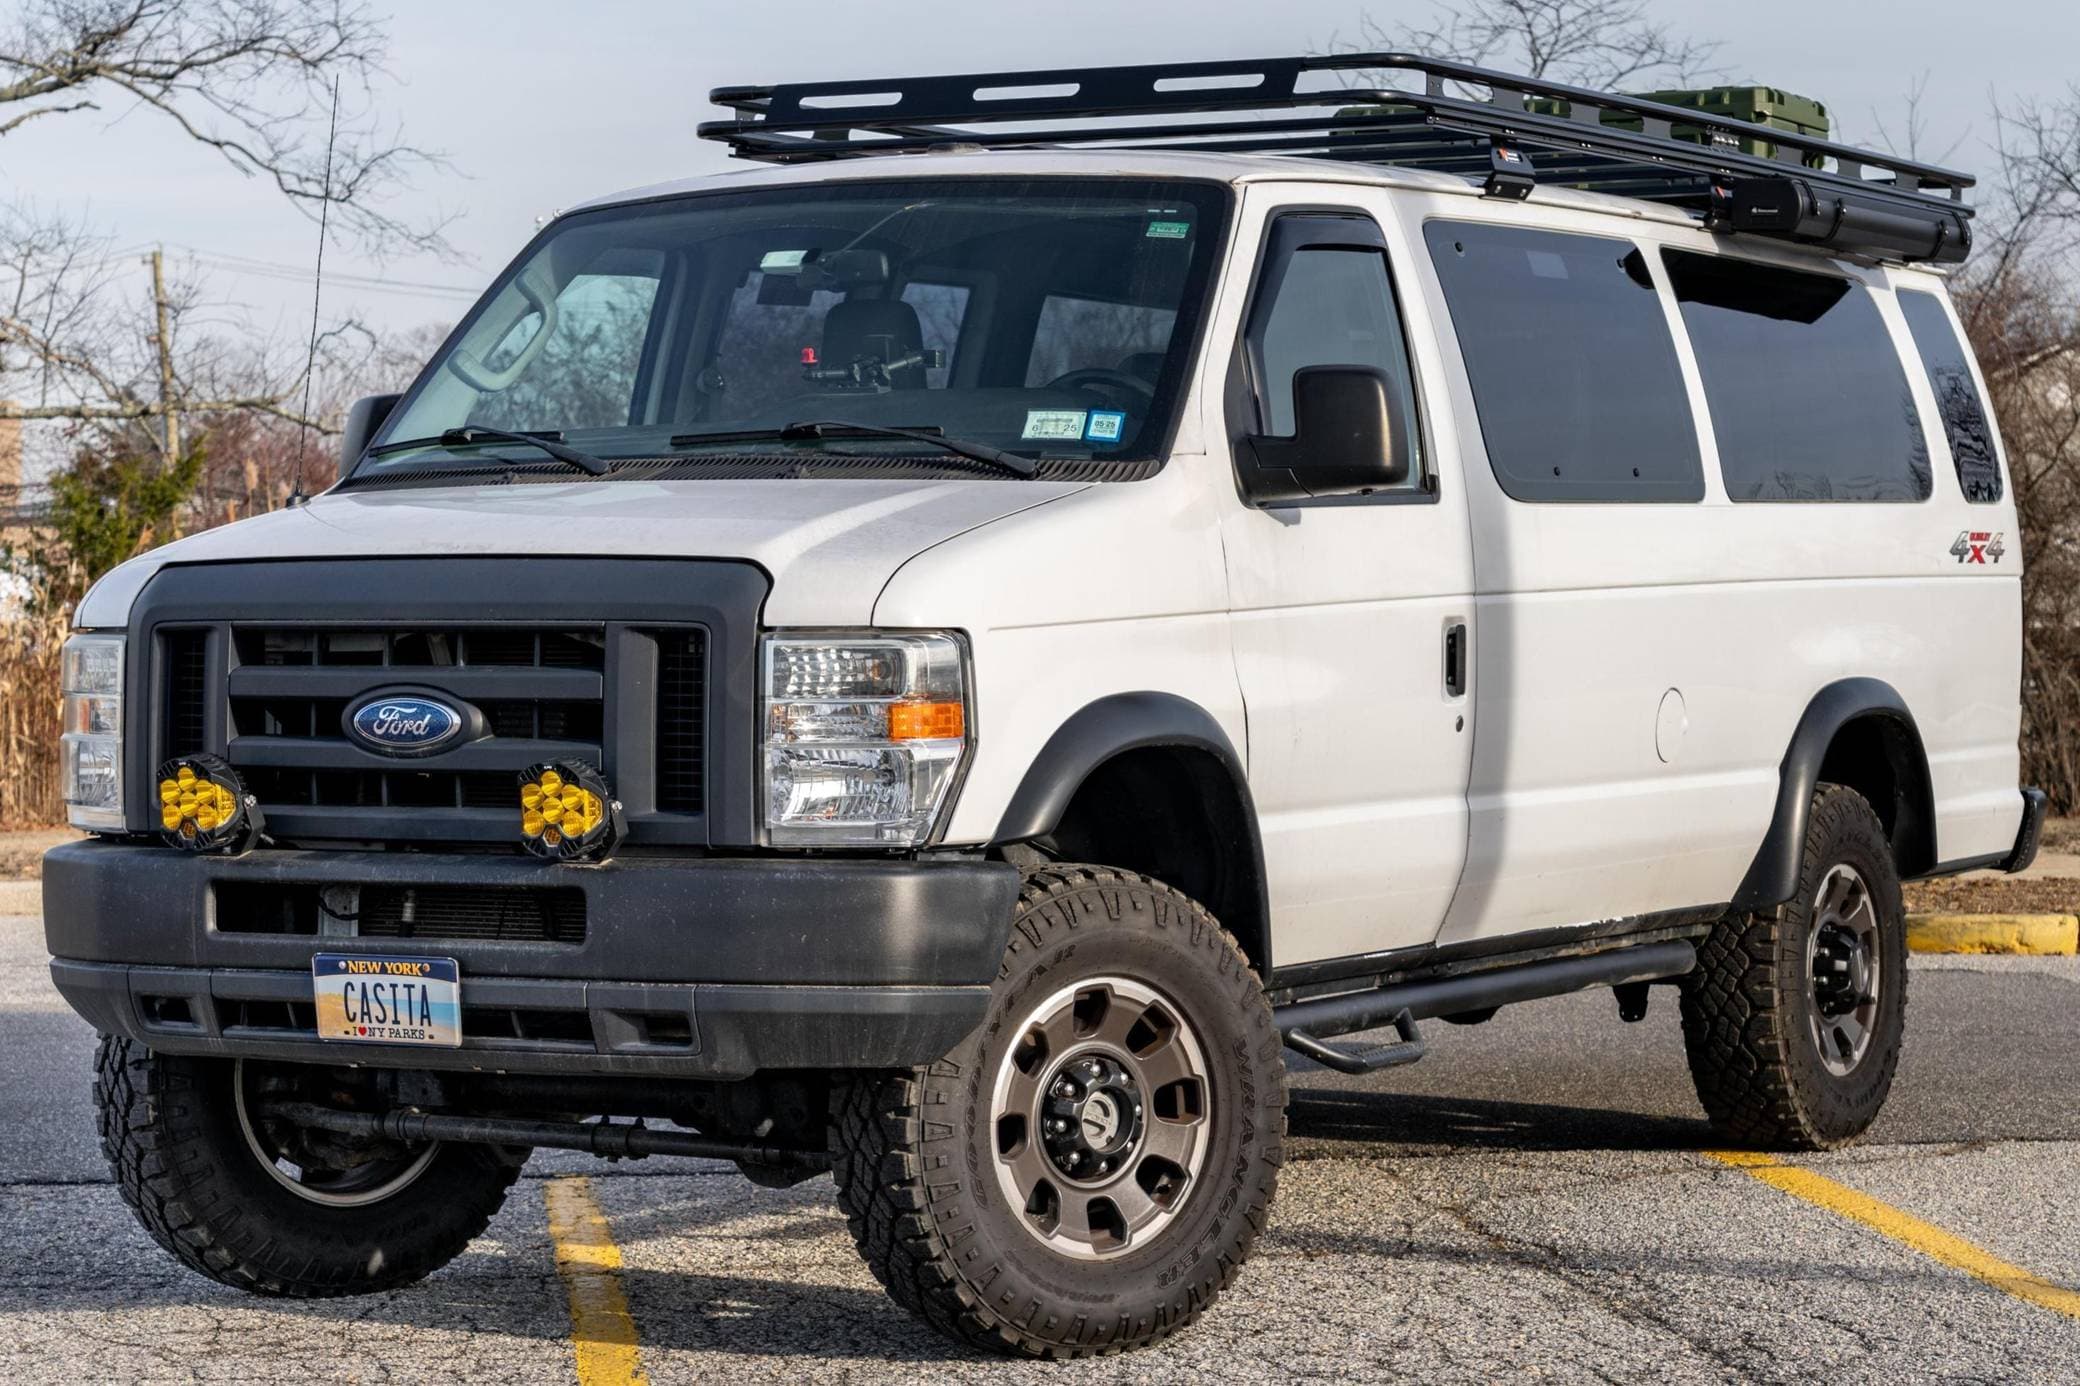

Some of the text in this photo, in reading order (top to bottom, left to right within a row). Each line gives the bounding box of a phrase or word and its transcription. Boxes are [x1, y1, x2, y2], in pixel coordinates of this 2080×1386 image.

[1063, 423, 1078, 433] 25
[373, 706, 432, 735] Ford
[347, 960, 423, 976] NEW YORK
[343, 981, 432, 1027] CASITA
[388, 1028, 425, 1040] PARKS
[1156, 1036, 1256, 1289] WRANGLER
